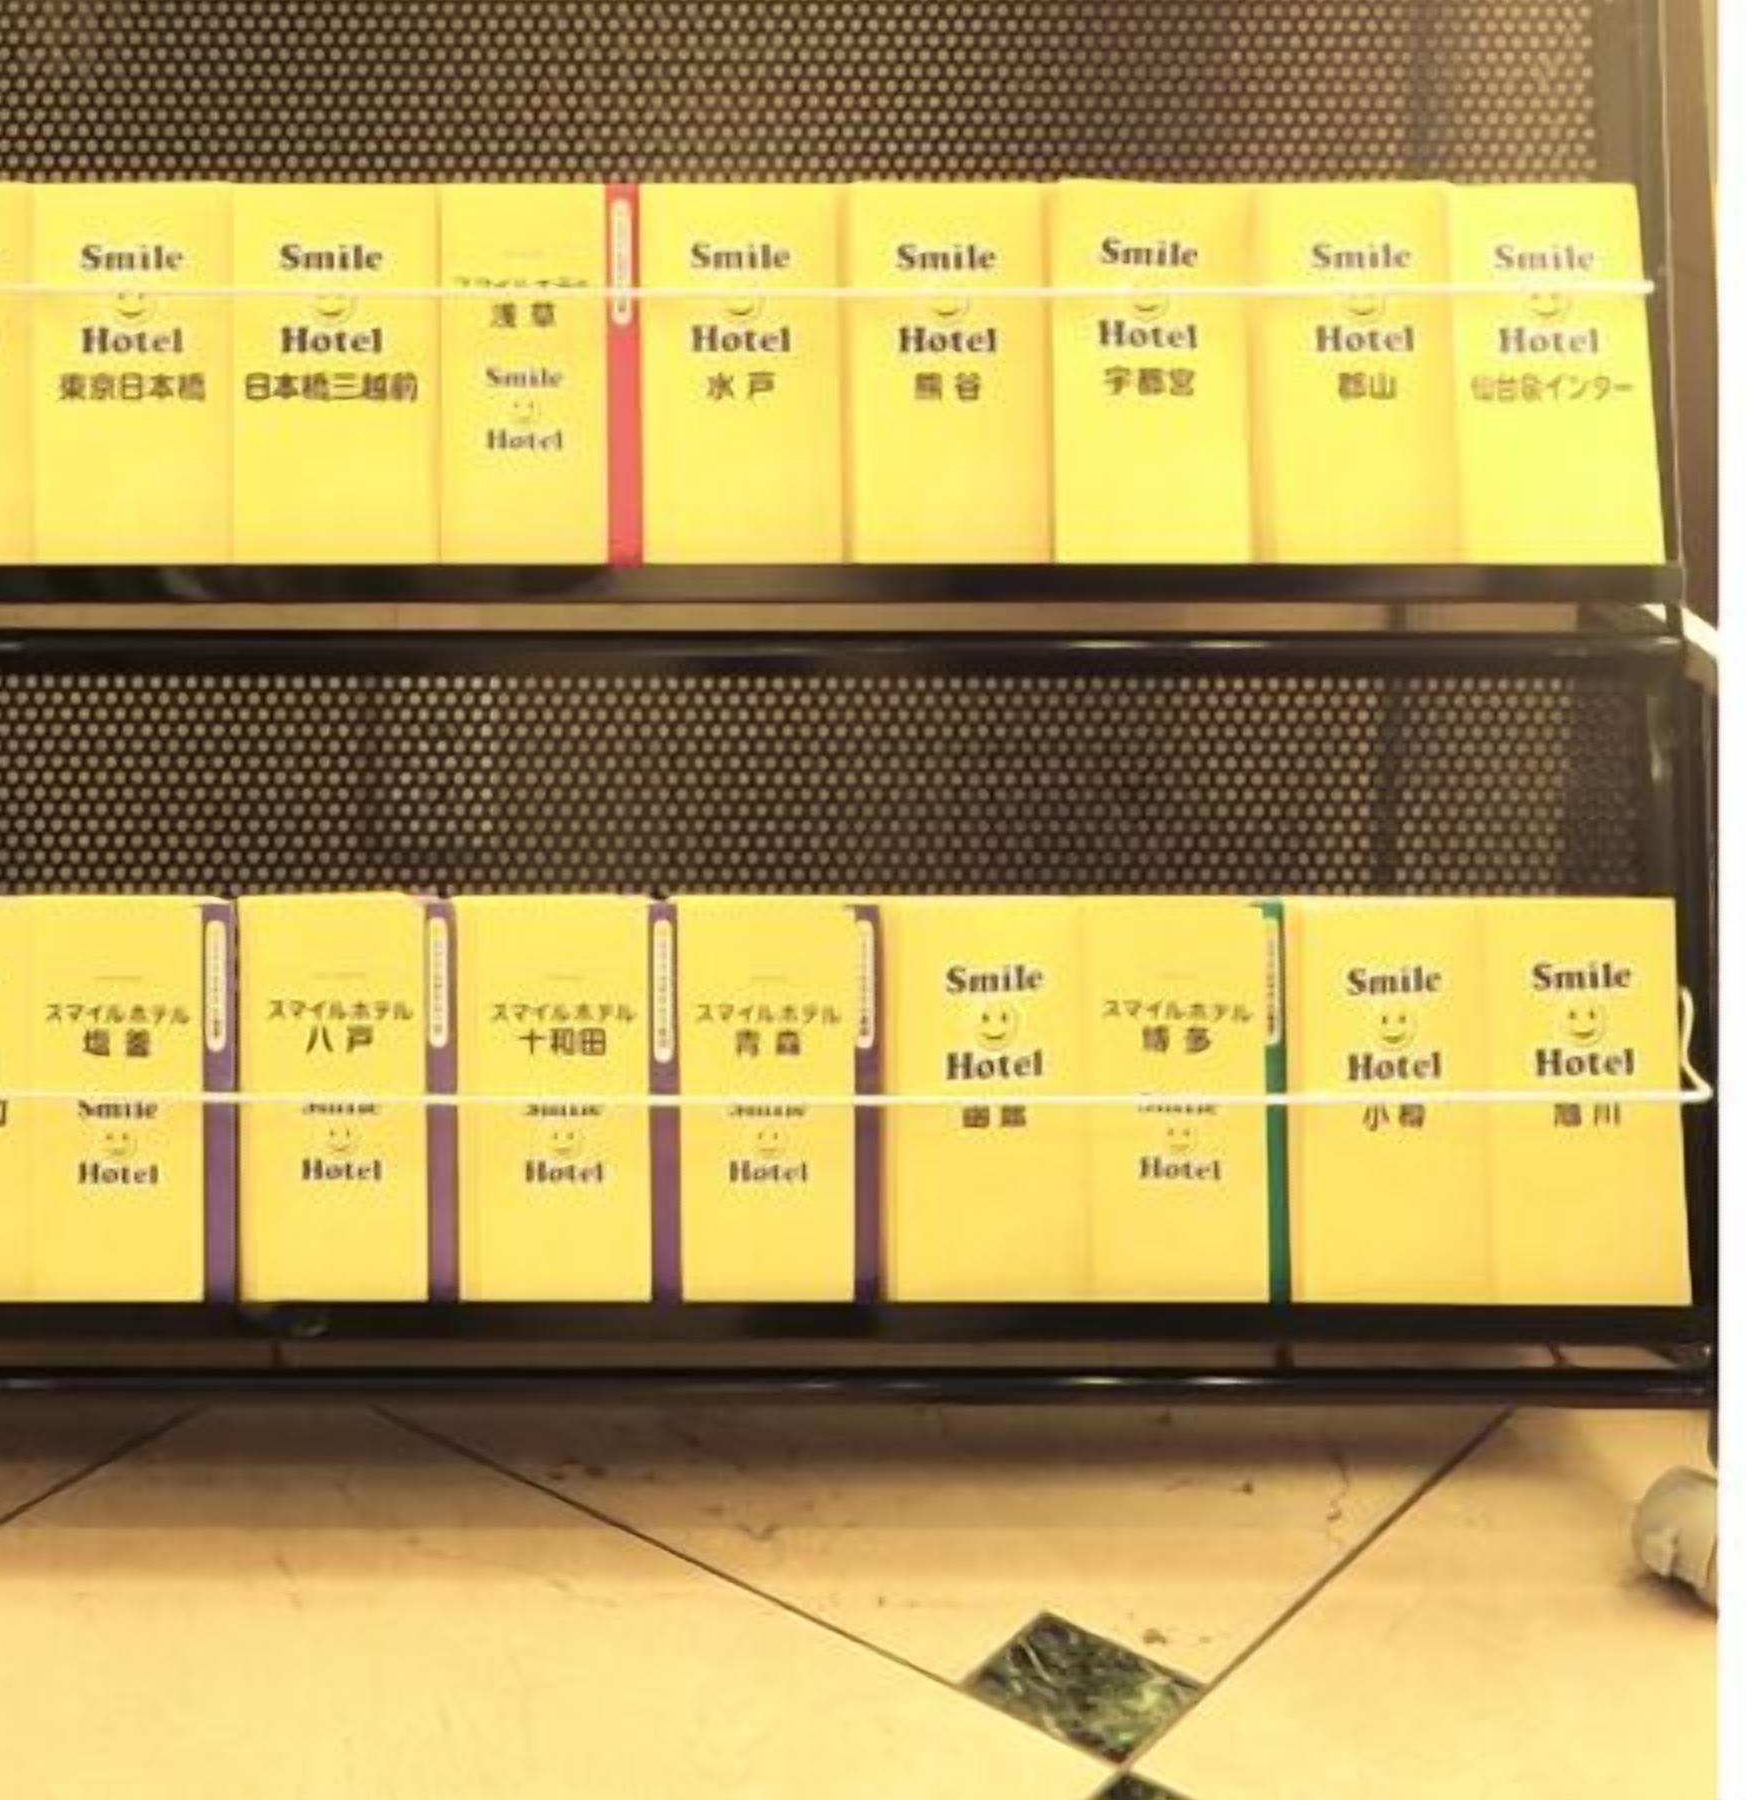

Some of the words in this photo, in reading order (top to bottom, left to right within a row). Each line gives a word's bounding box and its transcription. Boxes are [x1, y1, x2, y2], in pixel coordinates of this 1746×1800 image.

[82, 244, 185, 272] Smile
[280, 244, 384, 272] Smile
[691, 243, 792, 271] Smile
[897, 244, 998, 272] Smile
[1102, 238, 1200, 269] Smile
[1312, 243, 1412, 270] Smile
[1495, 245, 1596, 272] Smile
[82, 327, 184, 356] Hotel
[282, 326, 384, 356] Hotel
[692, 325, 792, 354] Hotel
[899, 326, 998, 354] Hotel
[1098, 319, 1199, 351] Hotel
[1316, 325, 1416, 354] Hotel
[1499, 327, 1600, 356] Hotel
[60, 372, 208, 404] 東京日本橋
[245, 372, 420, 404] 日本橋三越前
[486, 368, 564, 389] Smile
[707, 371, 777, 402] 水戸
[1338, 372, 1399, 402] 郡山
[487, 429, 564, 452] Hotel
[947, 965, 1044, 996] Smile
[1347, 966, 1443, 997] Smile
[1533, 962, 1633, 993] Smile
[306, 1025, 375, 1055] 八戸
[519, 1028, 608, 1058] 十和田
[736, 1029, 802, 1059] 青森
[1142, 1025, 1213, 1056] 博多
[947, 1049, 1044, 1082] Hotel
[1348, 1051, 1443, 1083] Hotel
[1536, 1048, 1636, 1078] Hotel
[79, 1162, 160, 1186] Hotel
[302, 1158, 383, 1182] Hotel
[526, 1160, 605, 1185] Hotel
[730, 1160, 809, 1184] Hotel
[1140, 1157, 1223, 1183] Hotel
